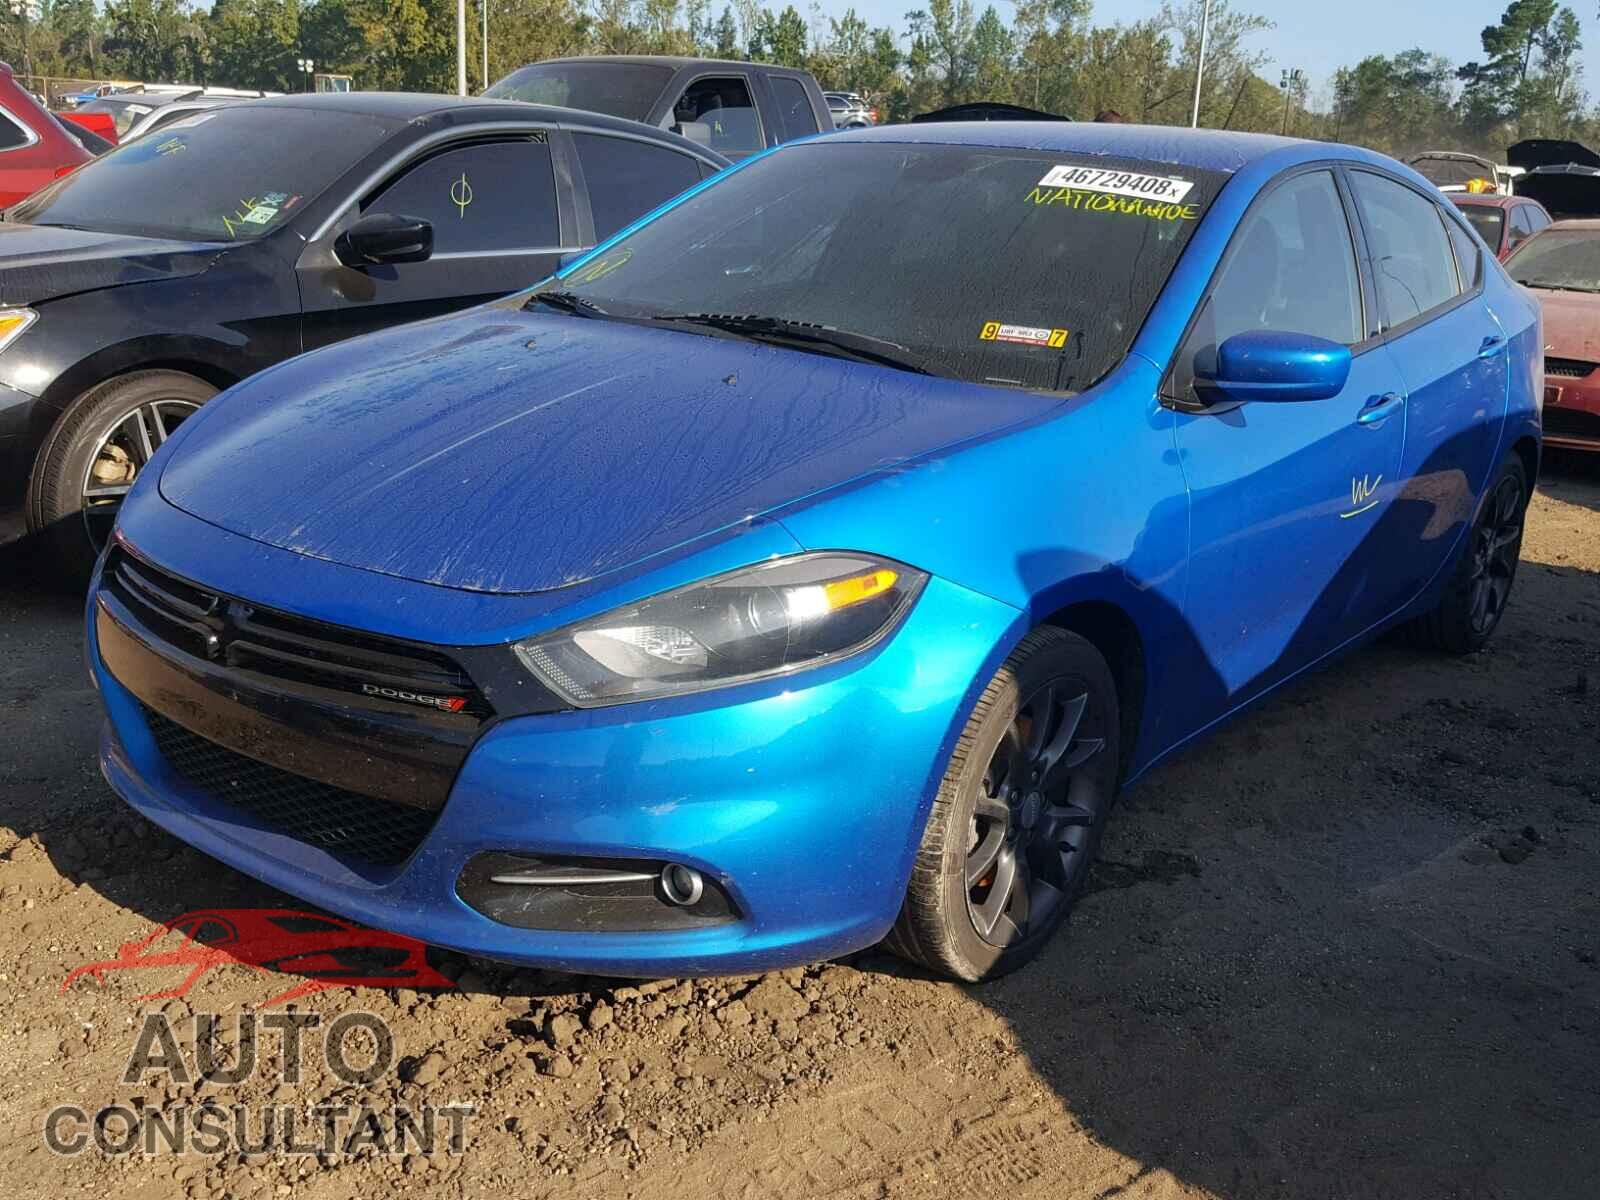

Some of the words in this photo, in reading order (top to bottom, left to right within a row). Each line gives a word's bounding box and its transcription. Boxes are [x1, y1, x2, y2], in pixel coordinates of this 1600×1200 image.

[984, 324, 998, 339] 9
[1053, 331, 1065, 346] 7
[362, 684, 453, 712] DODGE
